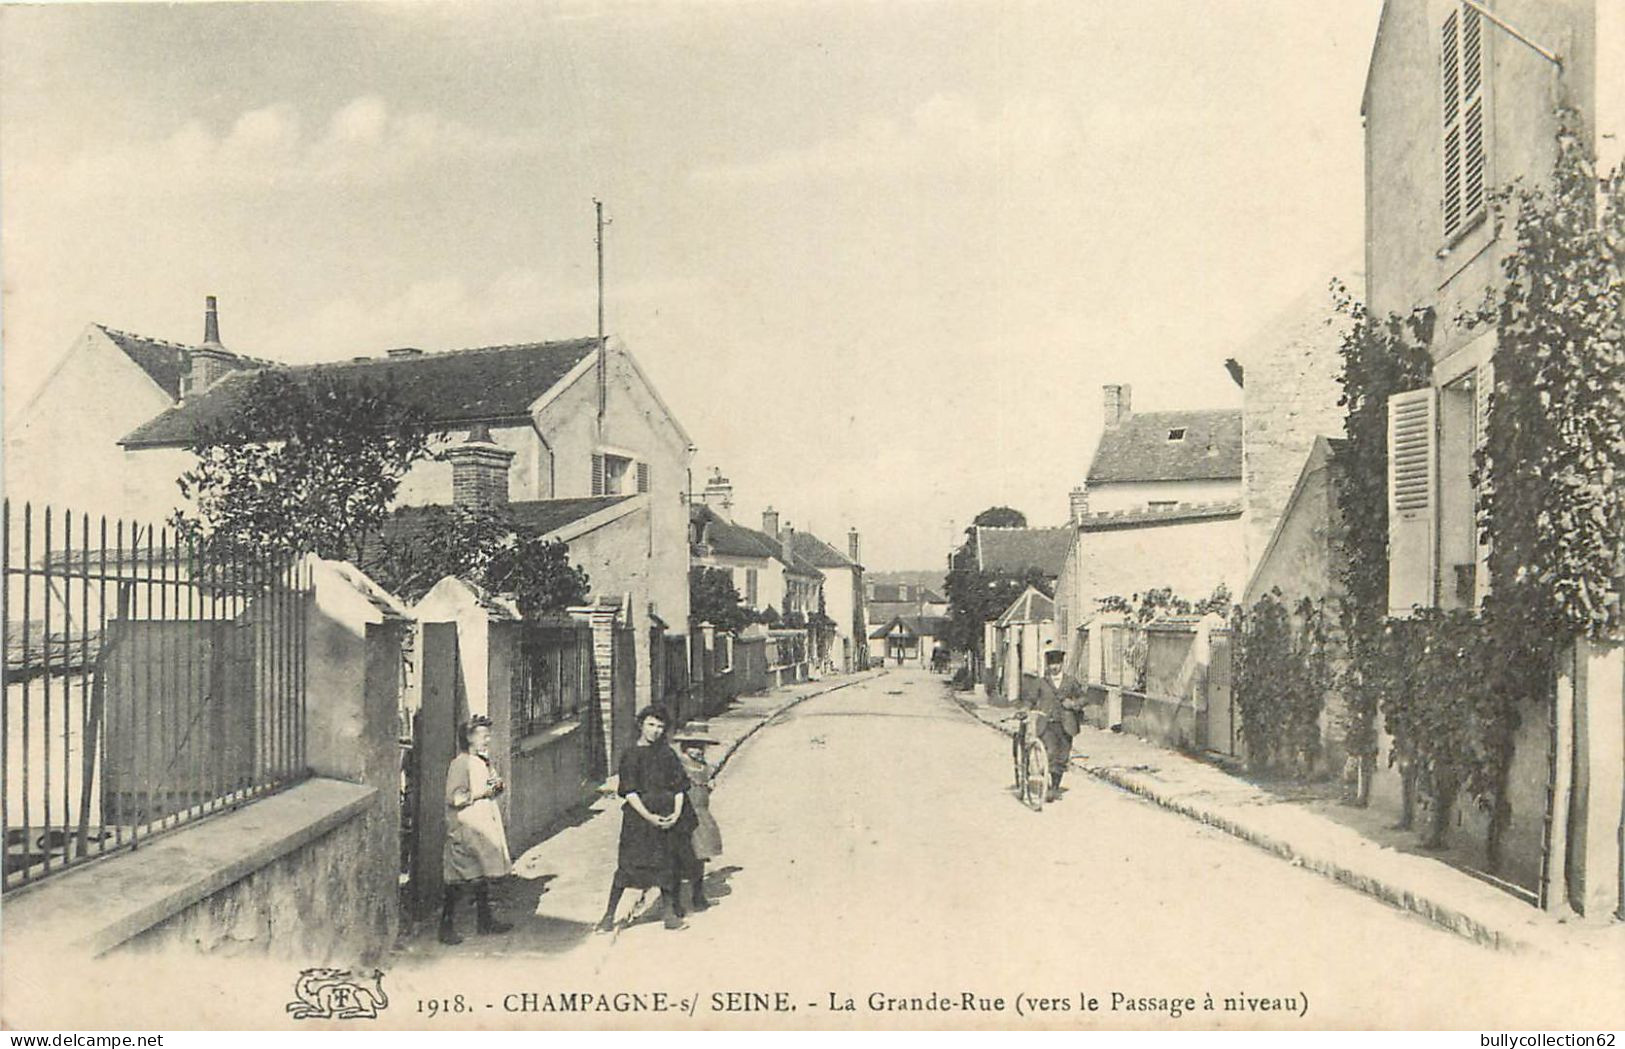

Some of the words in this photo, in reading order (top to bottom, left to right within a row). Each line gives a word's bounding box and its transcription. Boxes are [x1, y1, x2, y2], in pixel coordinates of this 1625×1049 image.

[417, 994, 473, 1018] 1918.
[503, 992, 699, 1017] CHAMPAGNE-s/
[711, 992, 797, 1012] SEINE.
[829, 992, 857, 1012] La
[867, 992, 1005, 1012] Grande-Rue
[1016, 993, 1071, 1017] (vers
[1080, 992, 1099, 1012] le
[1111, 992, 1196, 1018] Passage
[1203, 991, 1215, 1012] à
[1223, 992, 1309, 1018] niveau)
